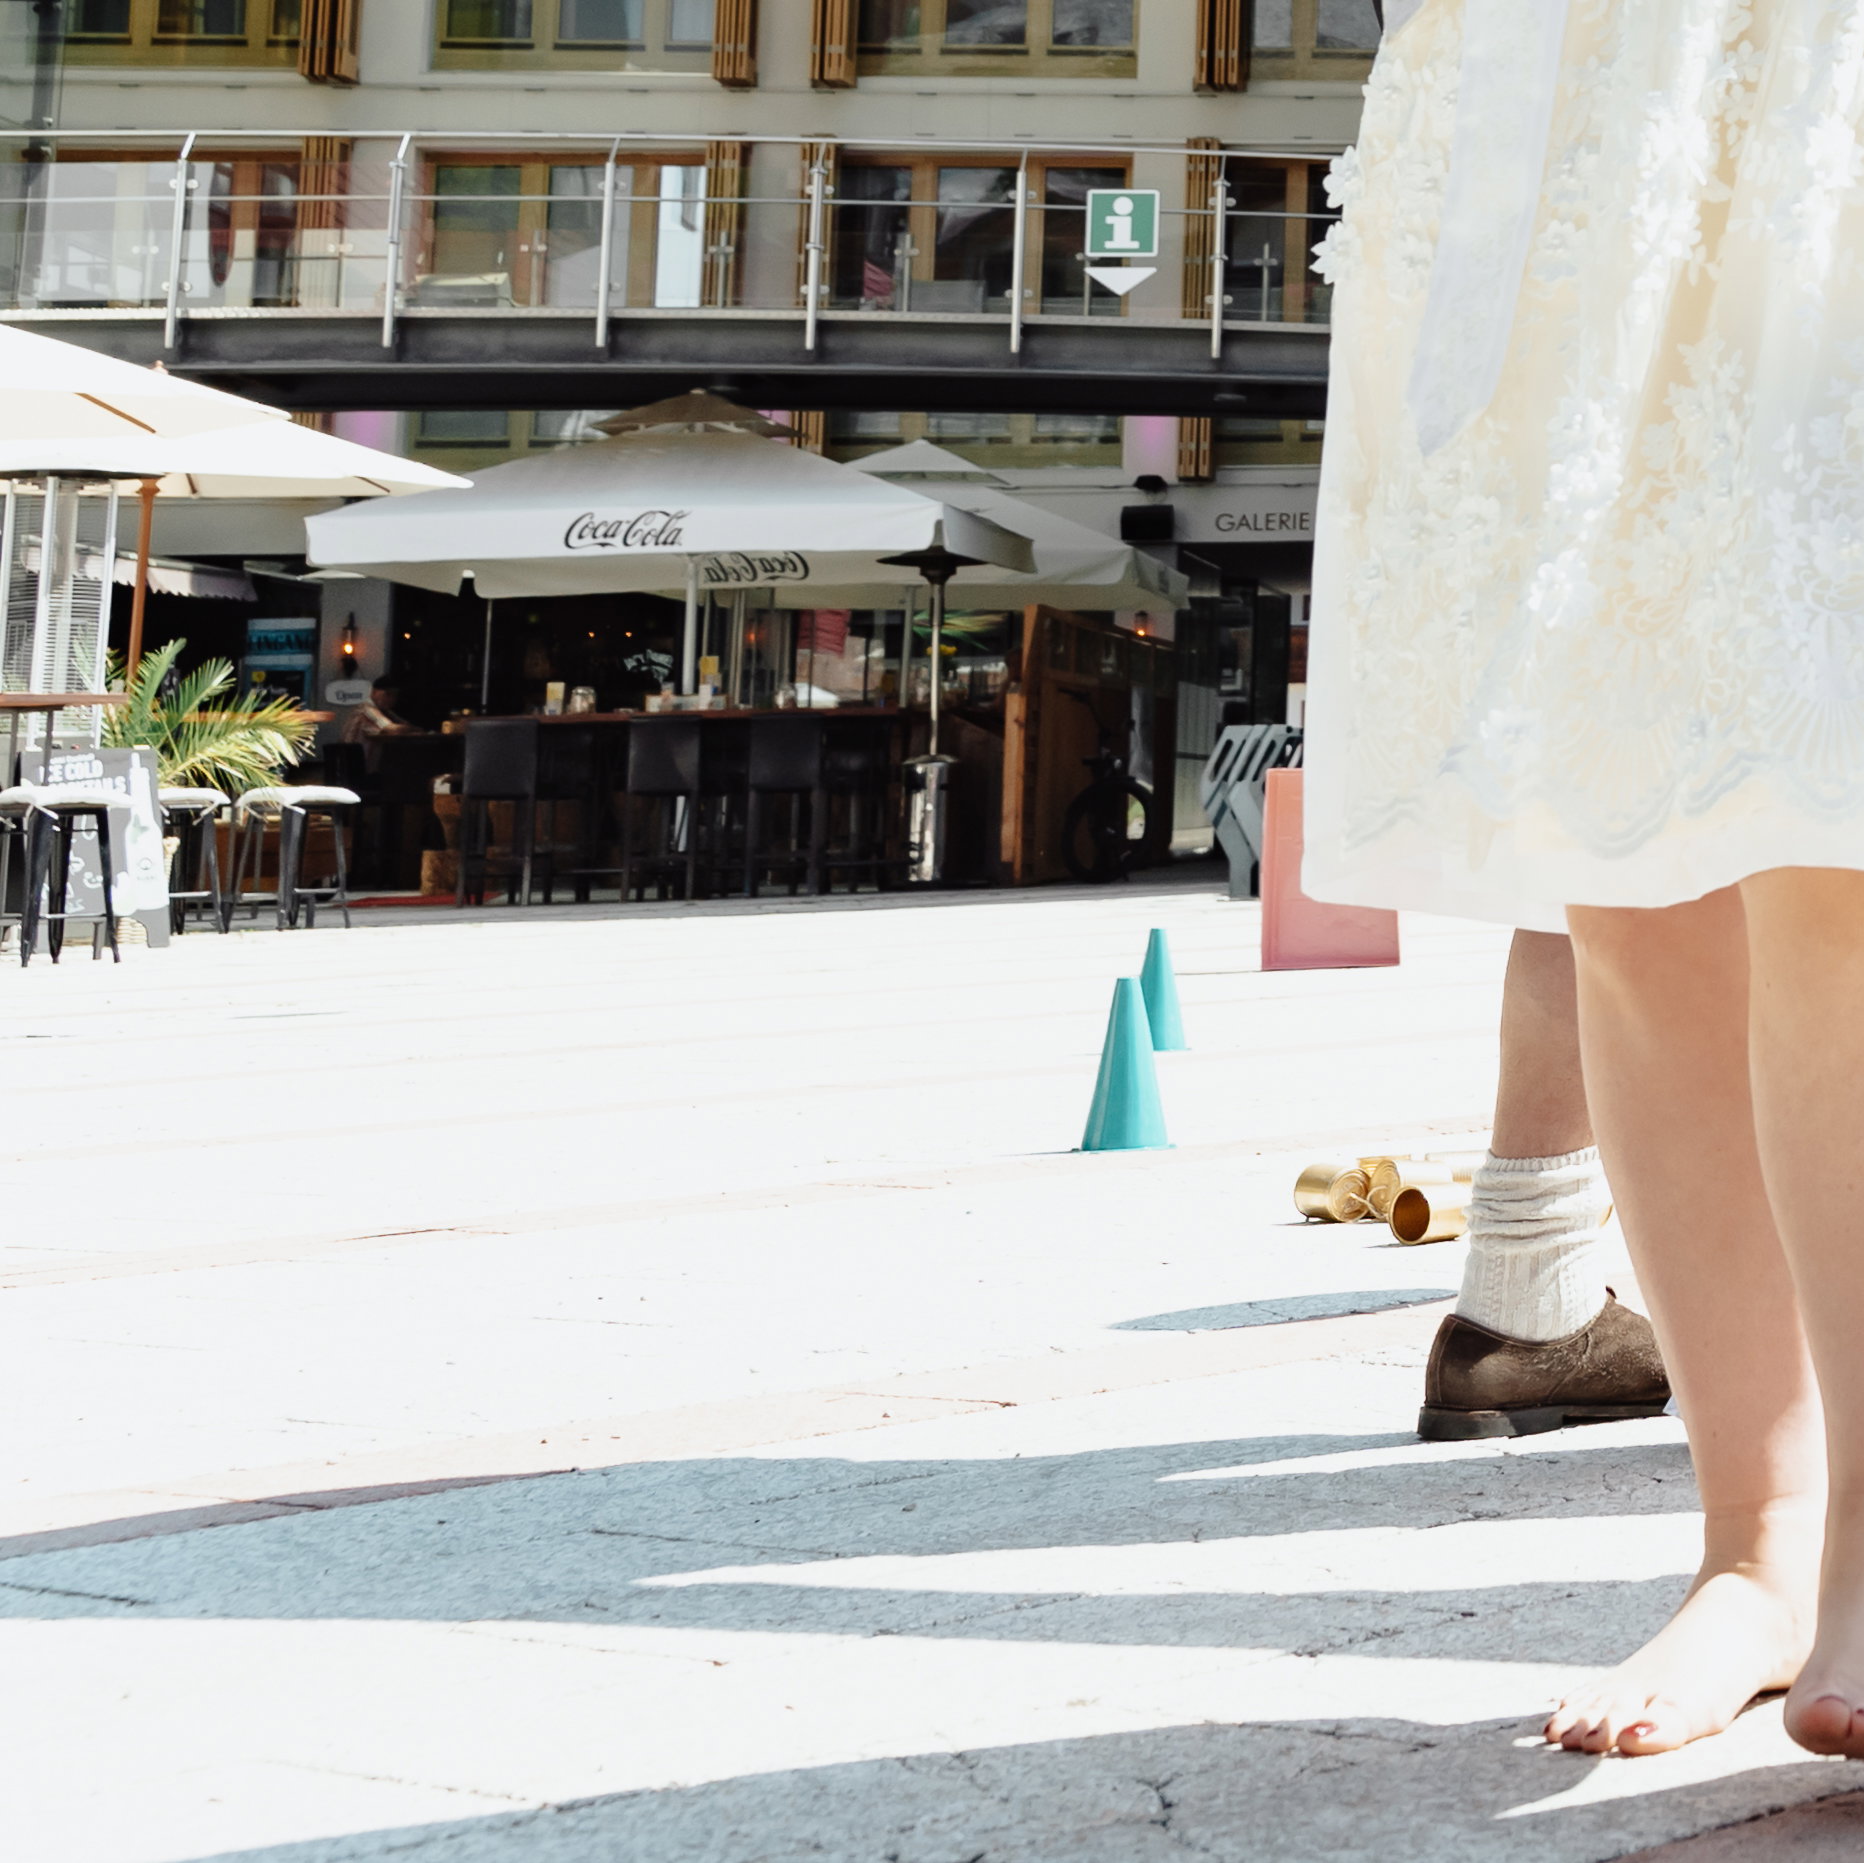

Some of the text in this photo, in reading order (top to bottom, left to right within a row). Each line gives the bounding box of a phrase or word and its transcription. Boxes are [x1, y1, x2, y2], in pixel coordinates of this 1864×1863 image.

[564, 510, 693, 549] Coca-Cola
[1215, 512, 1310, 532] GALERIE
[64, 759, 104, 781] COLD
